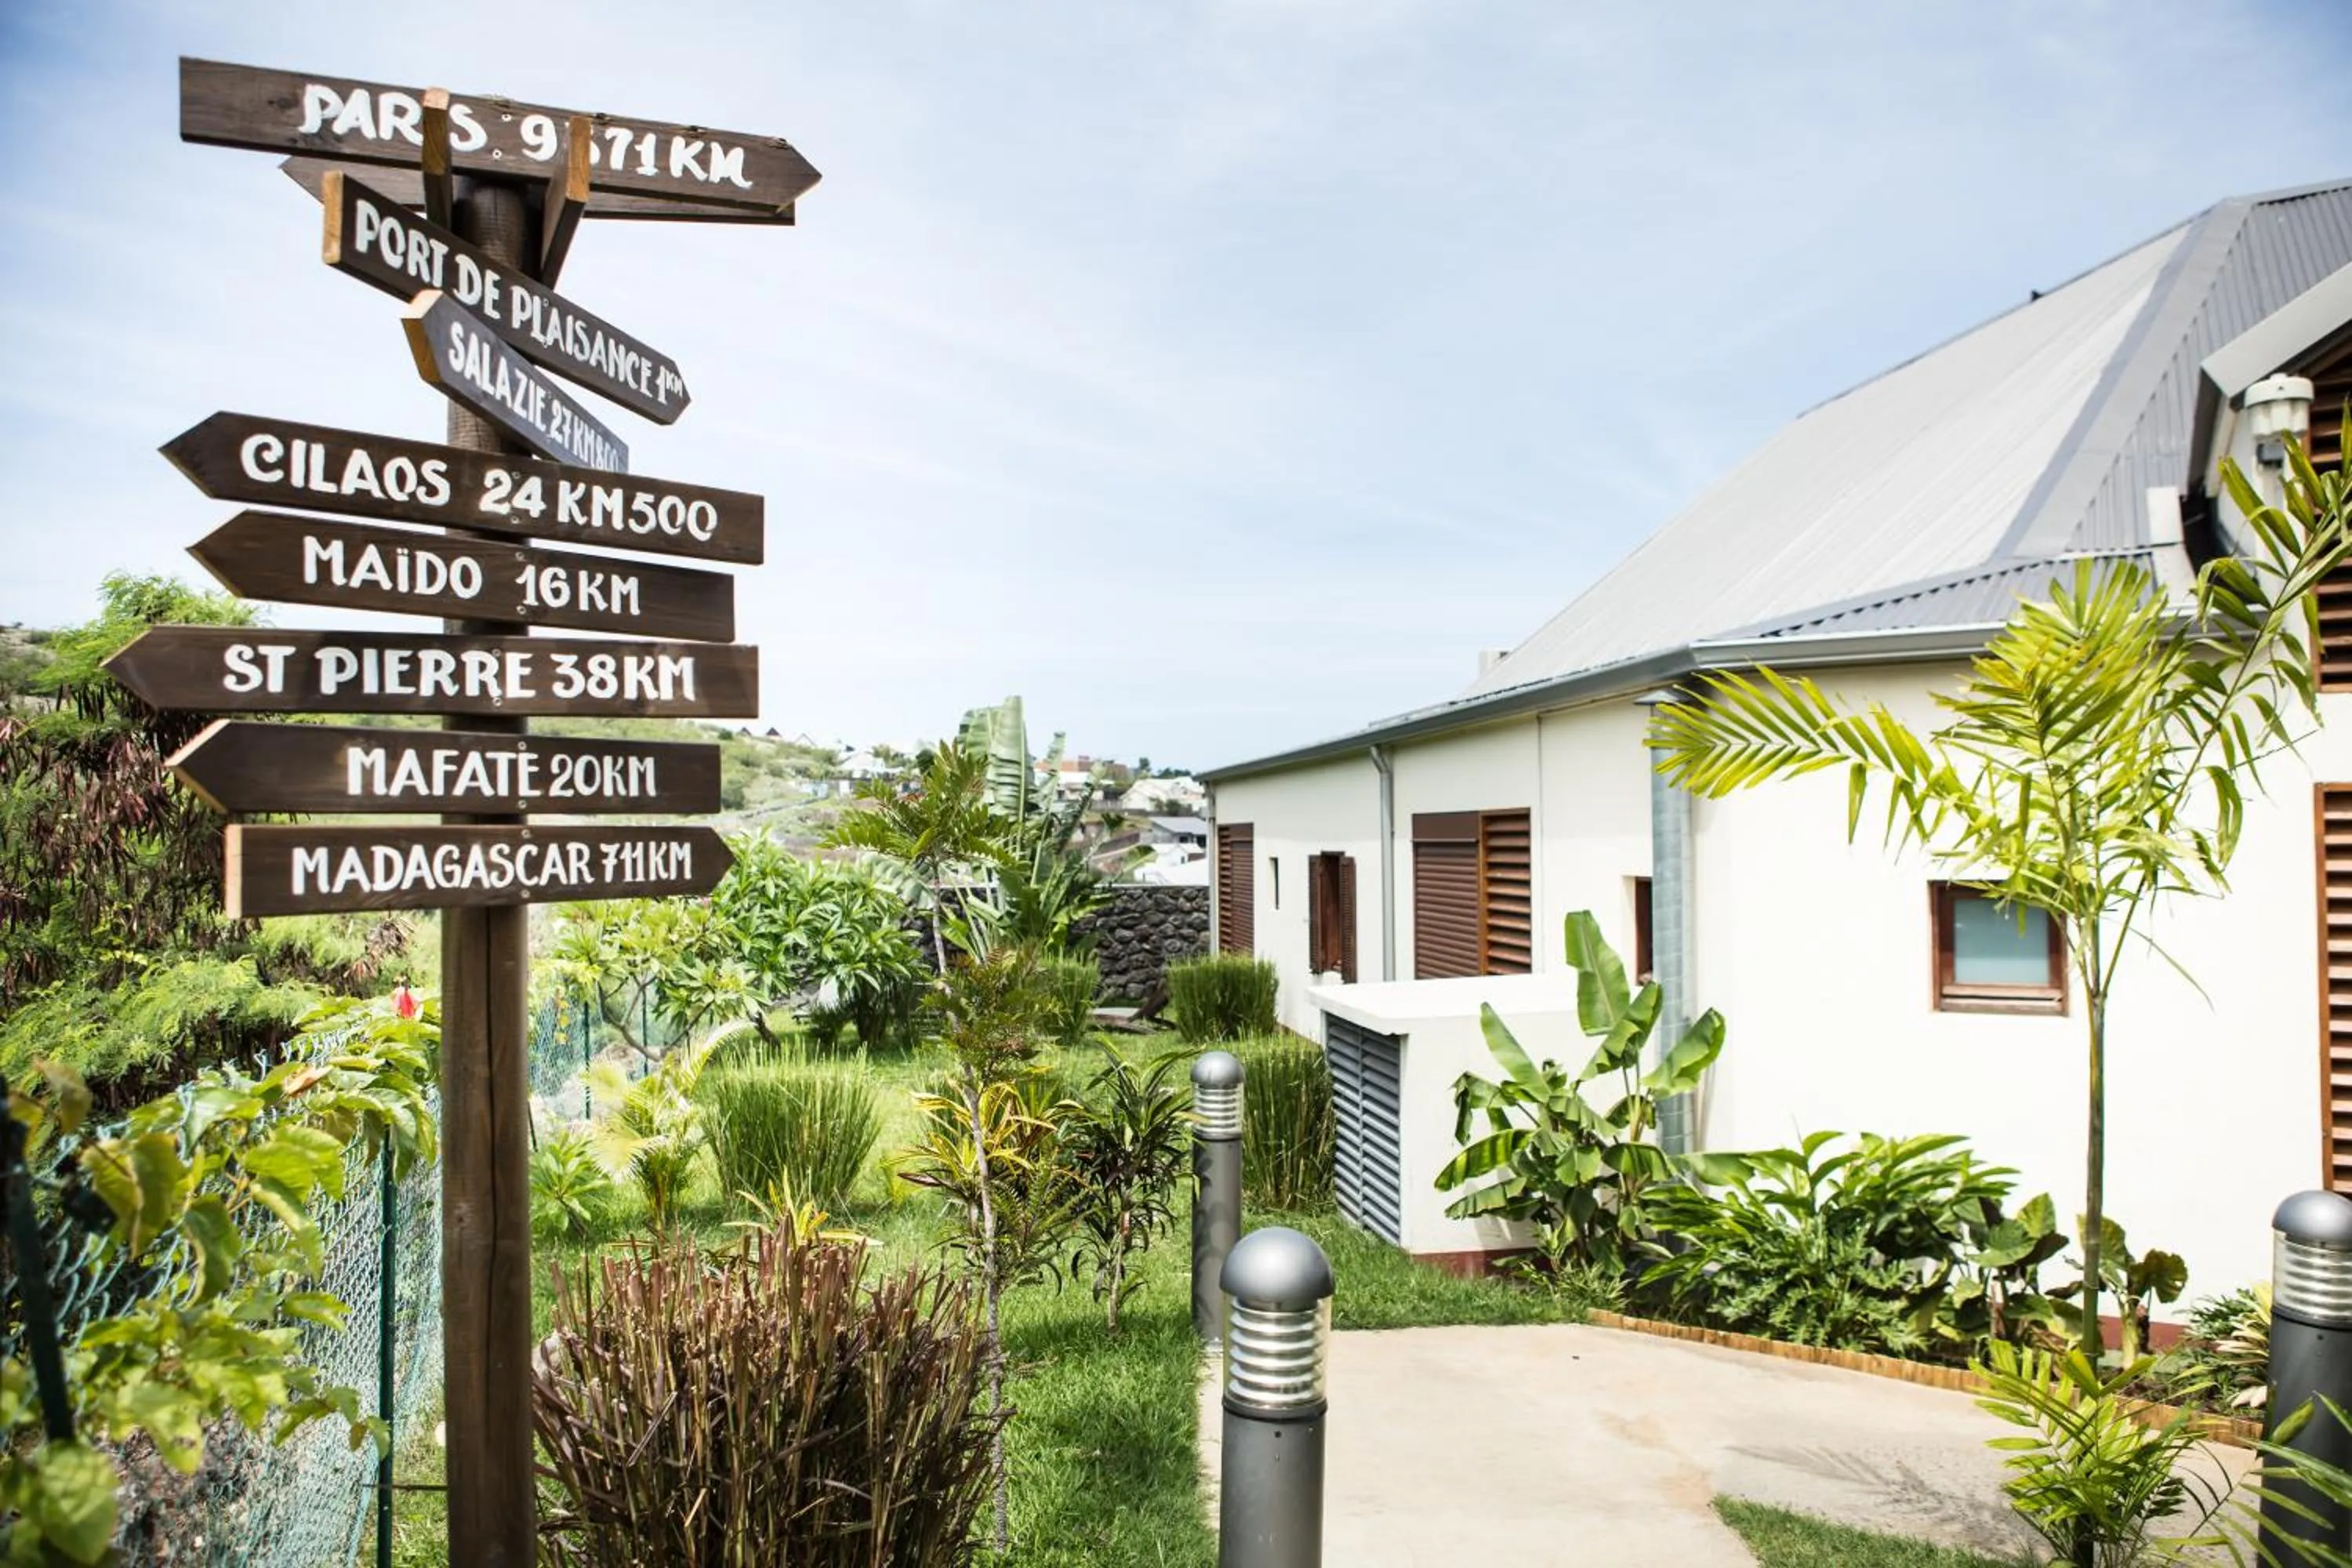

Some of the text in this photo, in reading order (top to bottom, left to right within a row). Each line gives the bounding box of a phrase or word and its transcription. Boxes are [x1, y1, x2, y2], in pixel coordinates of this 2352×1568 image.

[297, 83, 488, 152] PARS
[355, 198, 448, 288] PORT
[452, 254, 501, 319] DE
[510, 285, 653, 397] PLAISANCE
[448, 321, 546, 433] SALAZIE
[241, 434, 451, 506] CILAOS
[303, 535, 482, 599] MAÏDO
[223, 644, 296, 693] ST
[314, 647, 536, 699] PIERRE
[347, 746, 656, 797] MAFATE 20KM
[292, 841, 691, 895] MADAGASCAR 711KM
